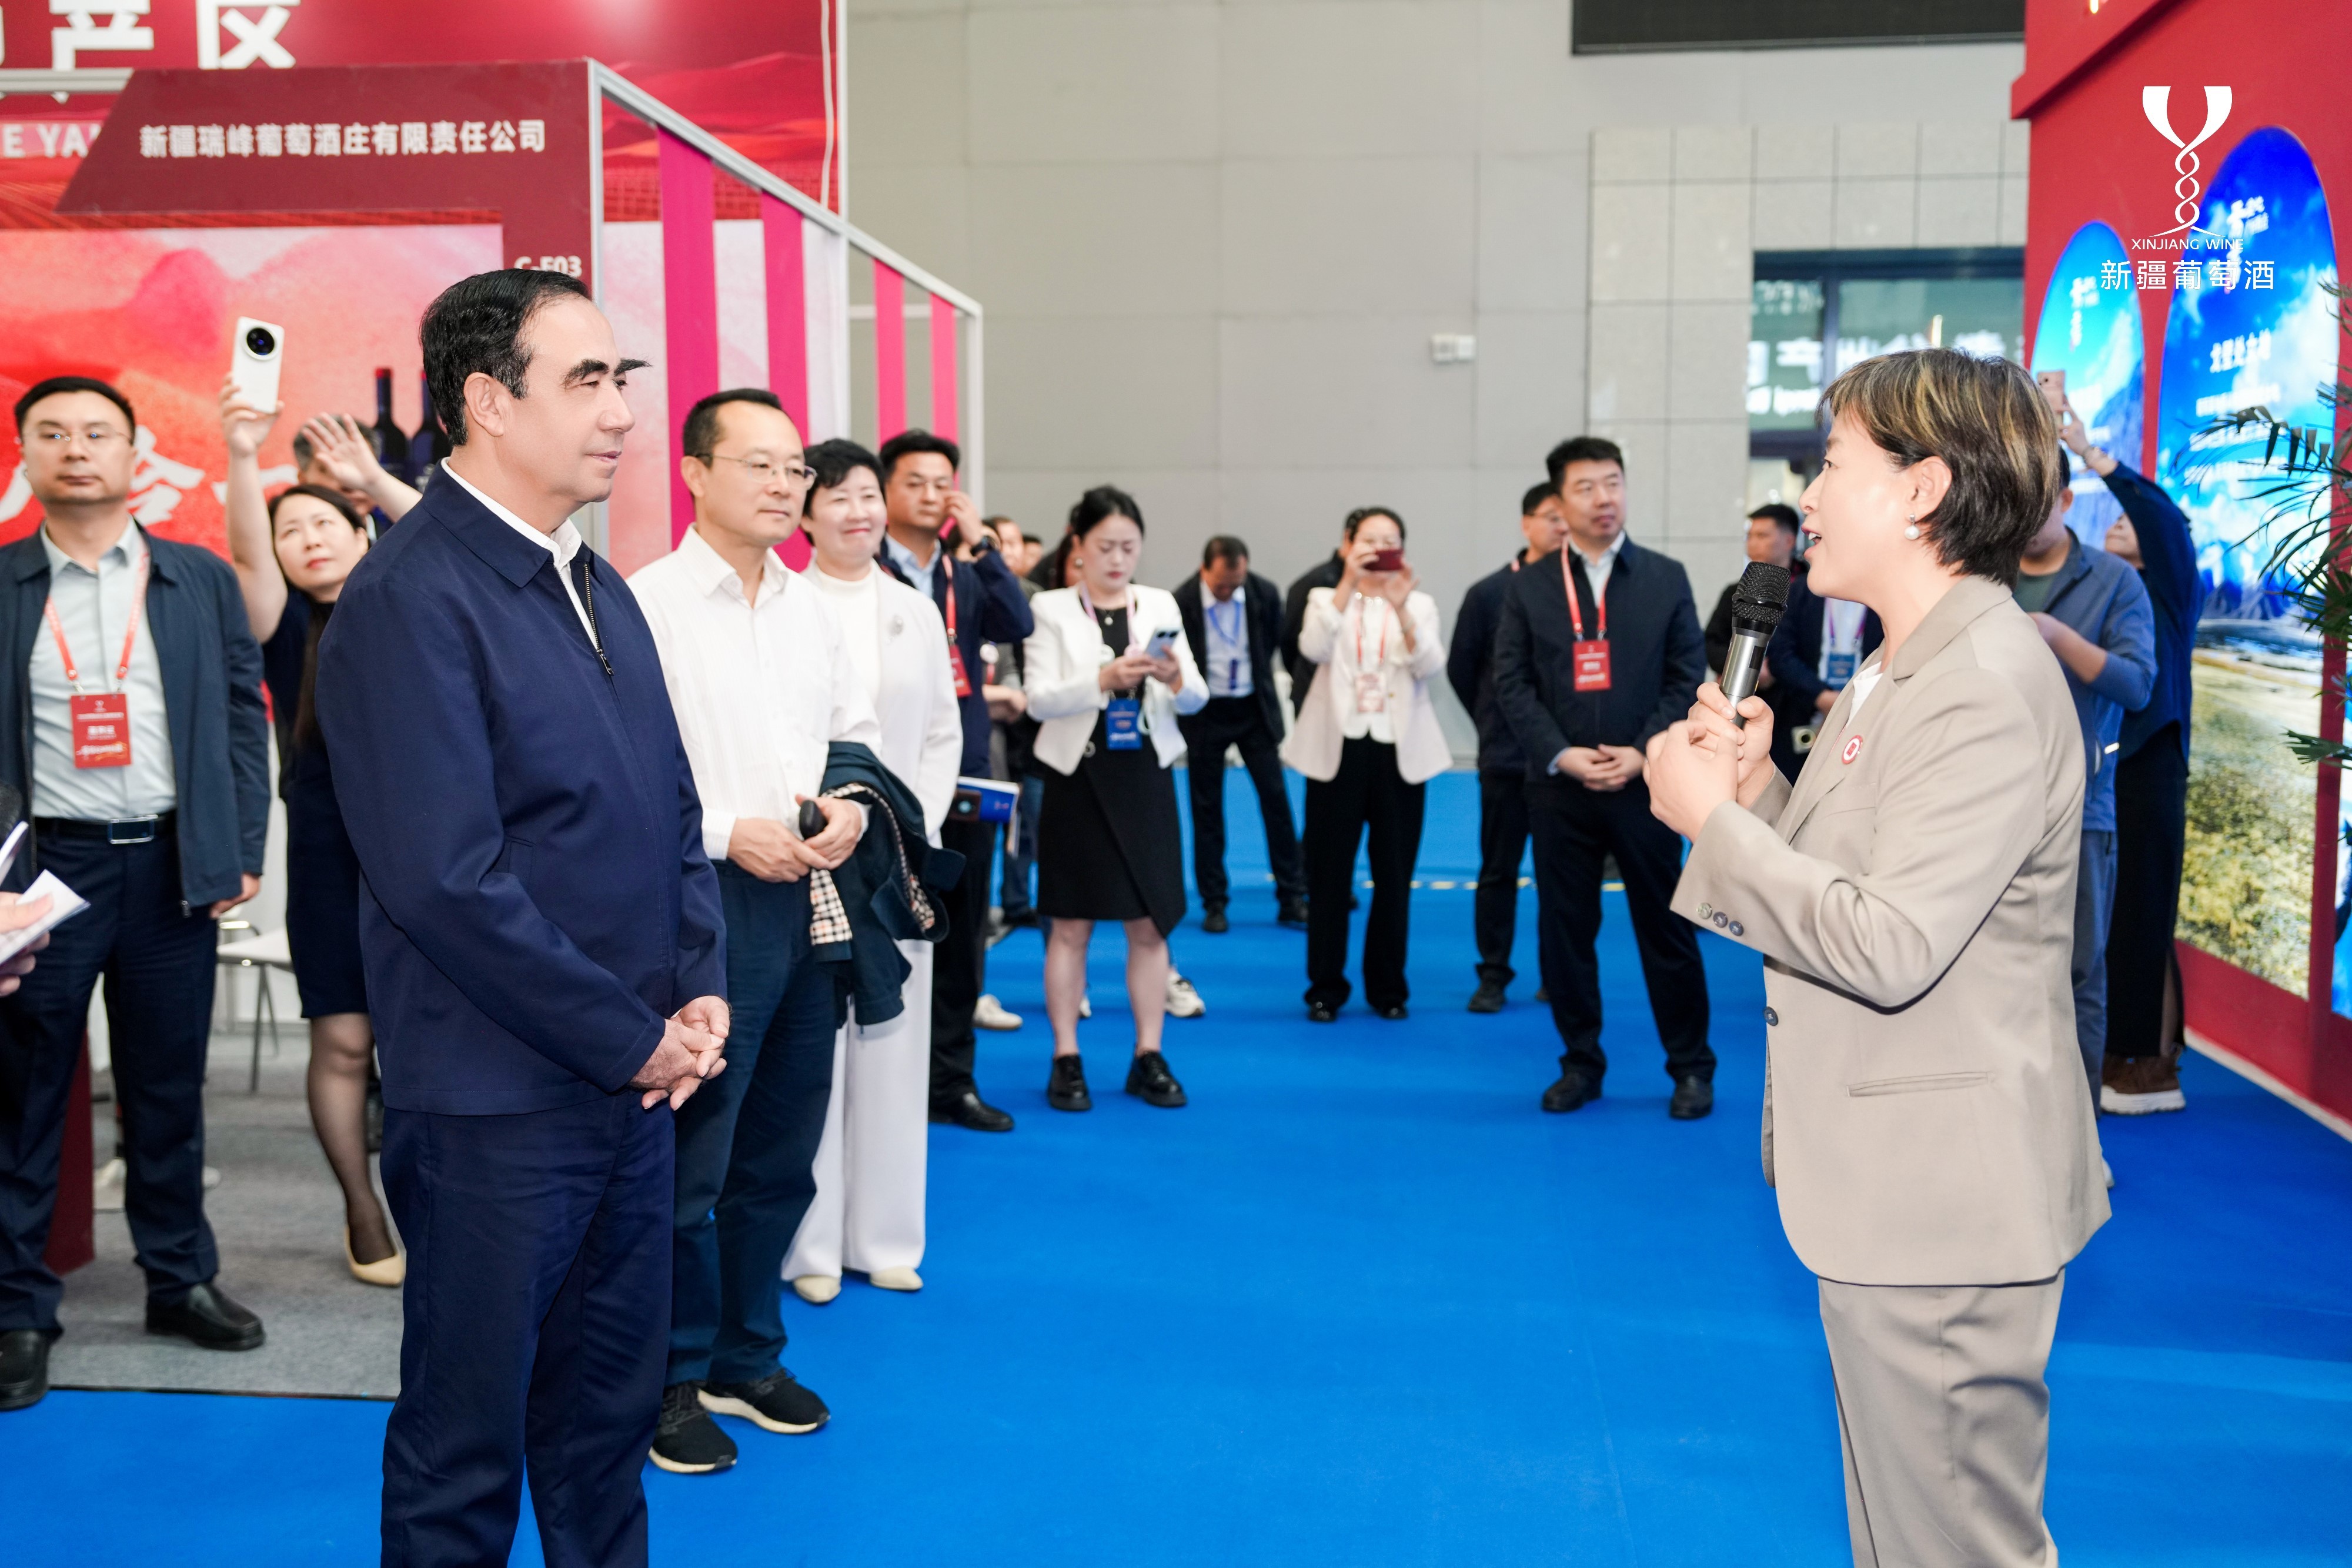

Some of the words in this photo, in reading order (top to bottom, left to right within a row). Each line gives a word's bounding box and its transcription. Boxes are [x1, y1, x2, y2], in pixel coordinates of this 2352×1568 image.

[0, 0, 300, 104] 产区
[139, 119, 545, 158] 新疆瑞峰葡萄酒庄有限责任公司
